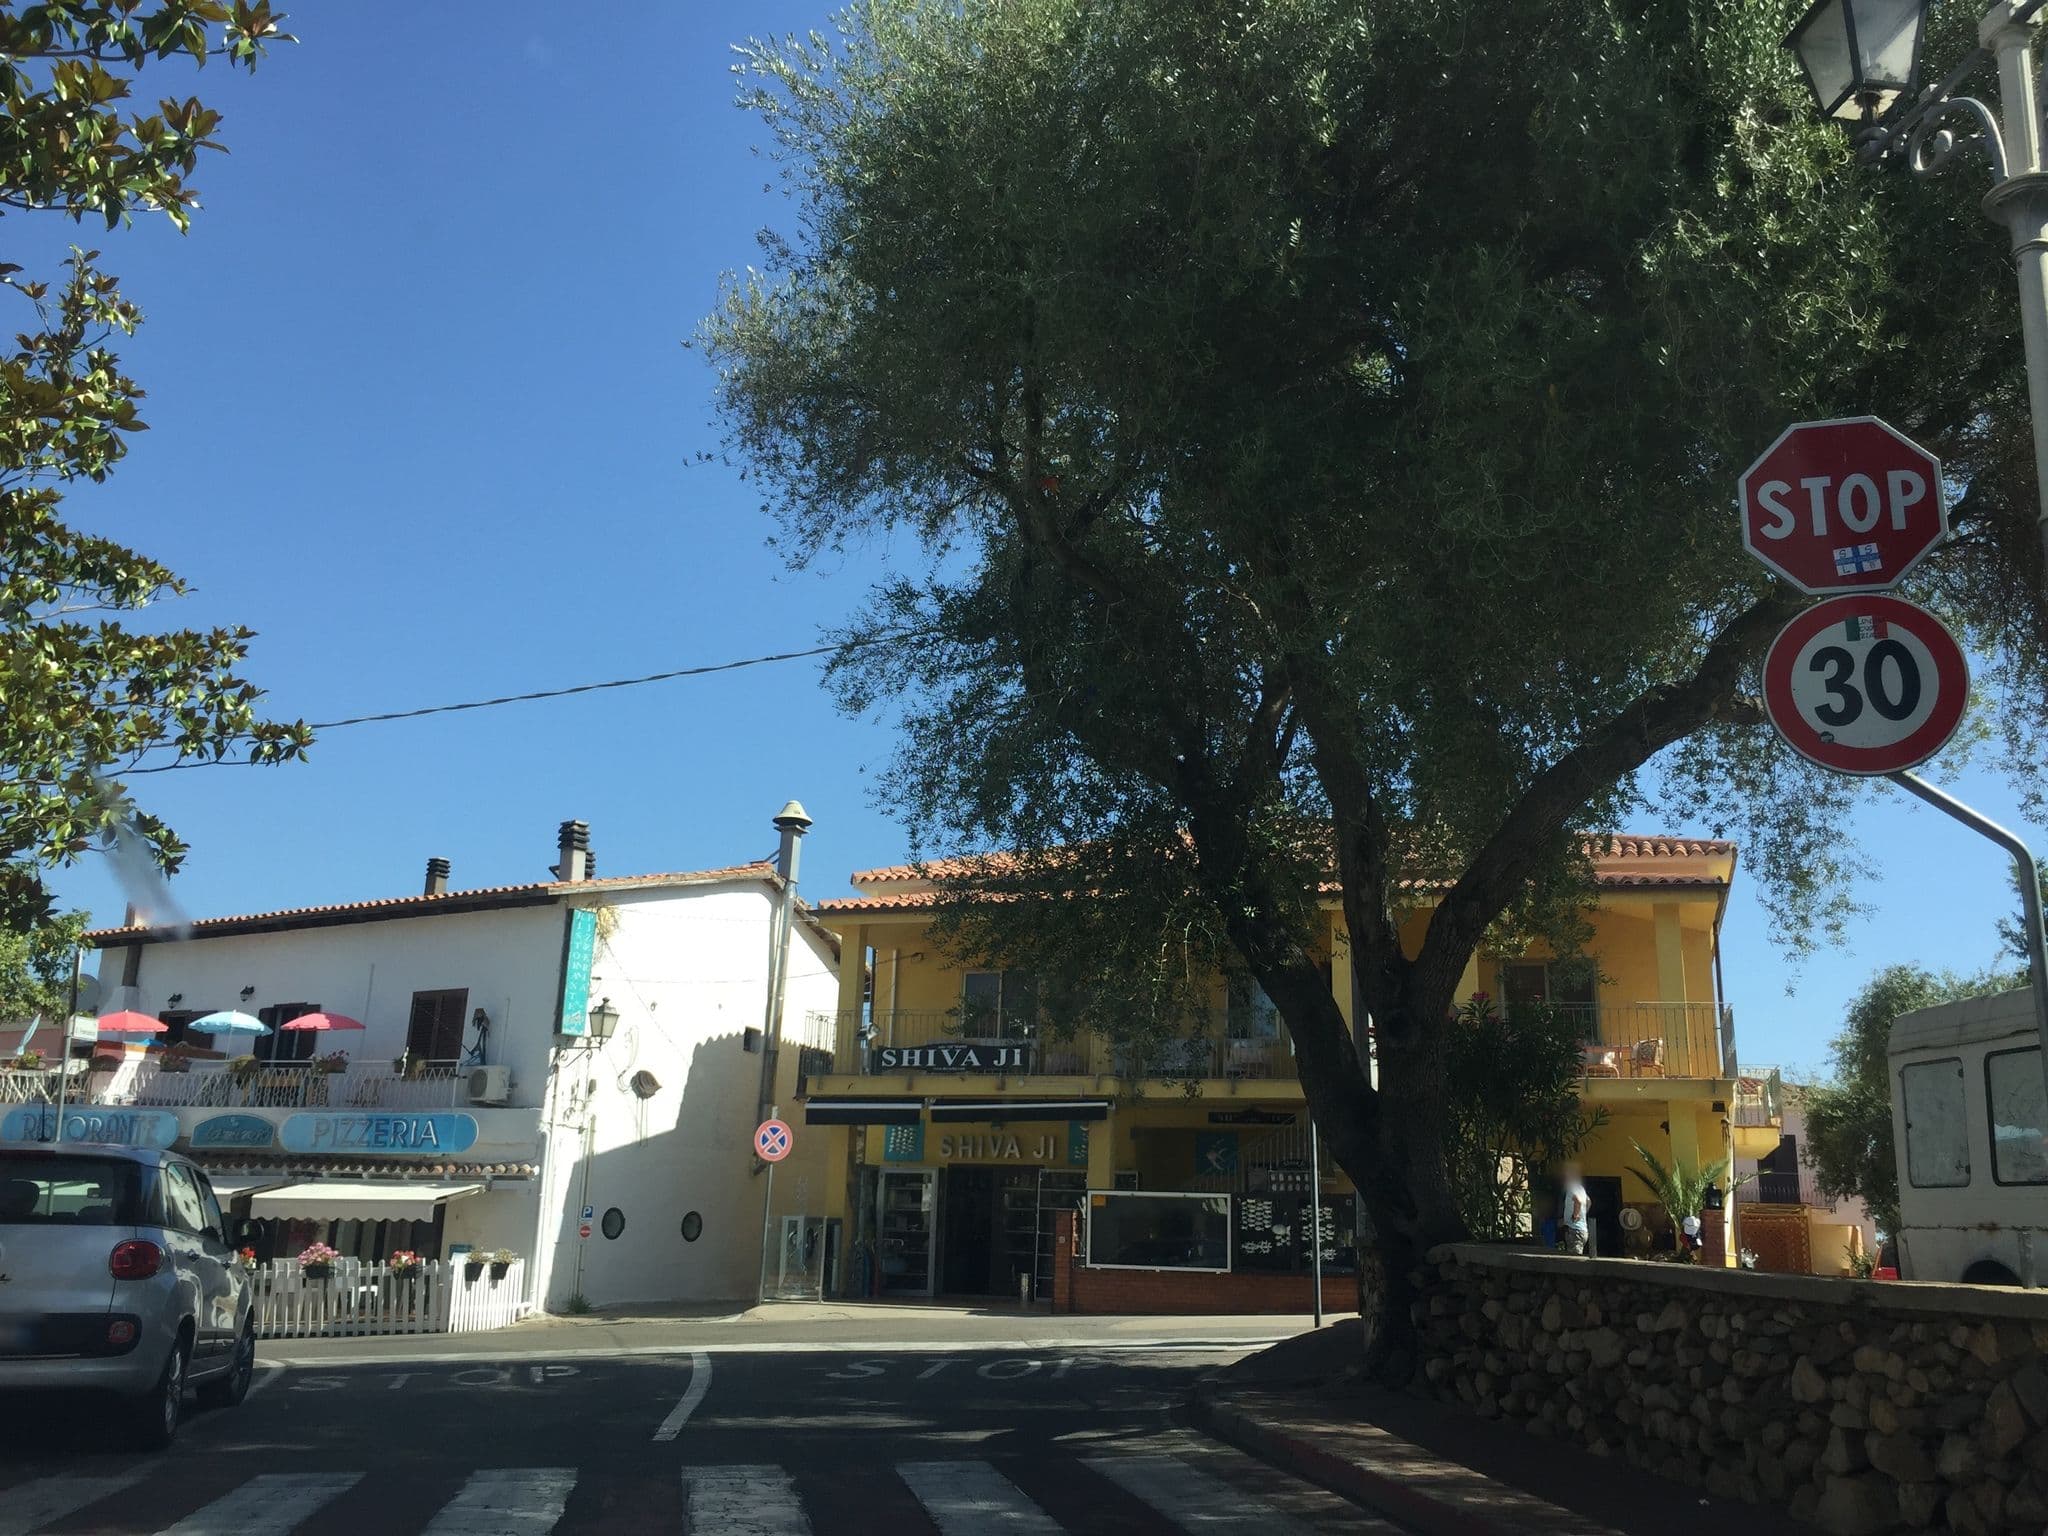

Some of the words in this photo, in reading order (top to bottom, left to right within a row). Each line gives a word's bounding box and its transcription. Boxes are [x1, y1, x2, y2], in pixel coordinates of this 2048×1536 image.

[1757, 470, 1926, 540] STOP
[1809, 639, 1921, 727] 30
[881, 1049, 982, 1068] SHIVA
[993, 1048, 1023, 1067] JI
[23, 1113, 160, 1145] RISORANTE
[311, 1118, 441, 1148] PIZZERIA
[940, 1135, 1021, 1159] SHIVA
[1033, 1135, 1056, 1160] JI
[288, 1366, 580, 1391] STOP
[825, 1358, 1108, 1381] STOP
